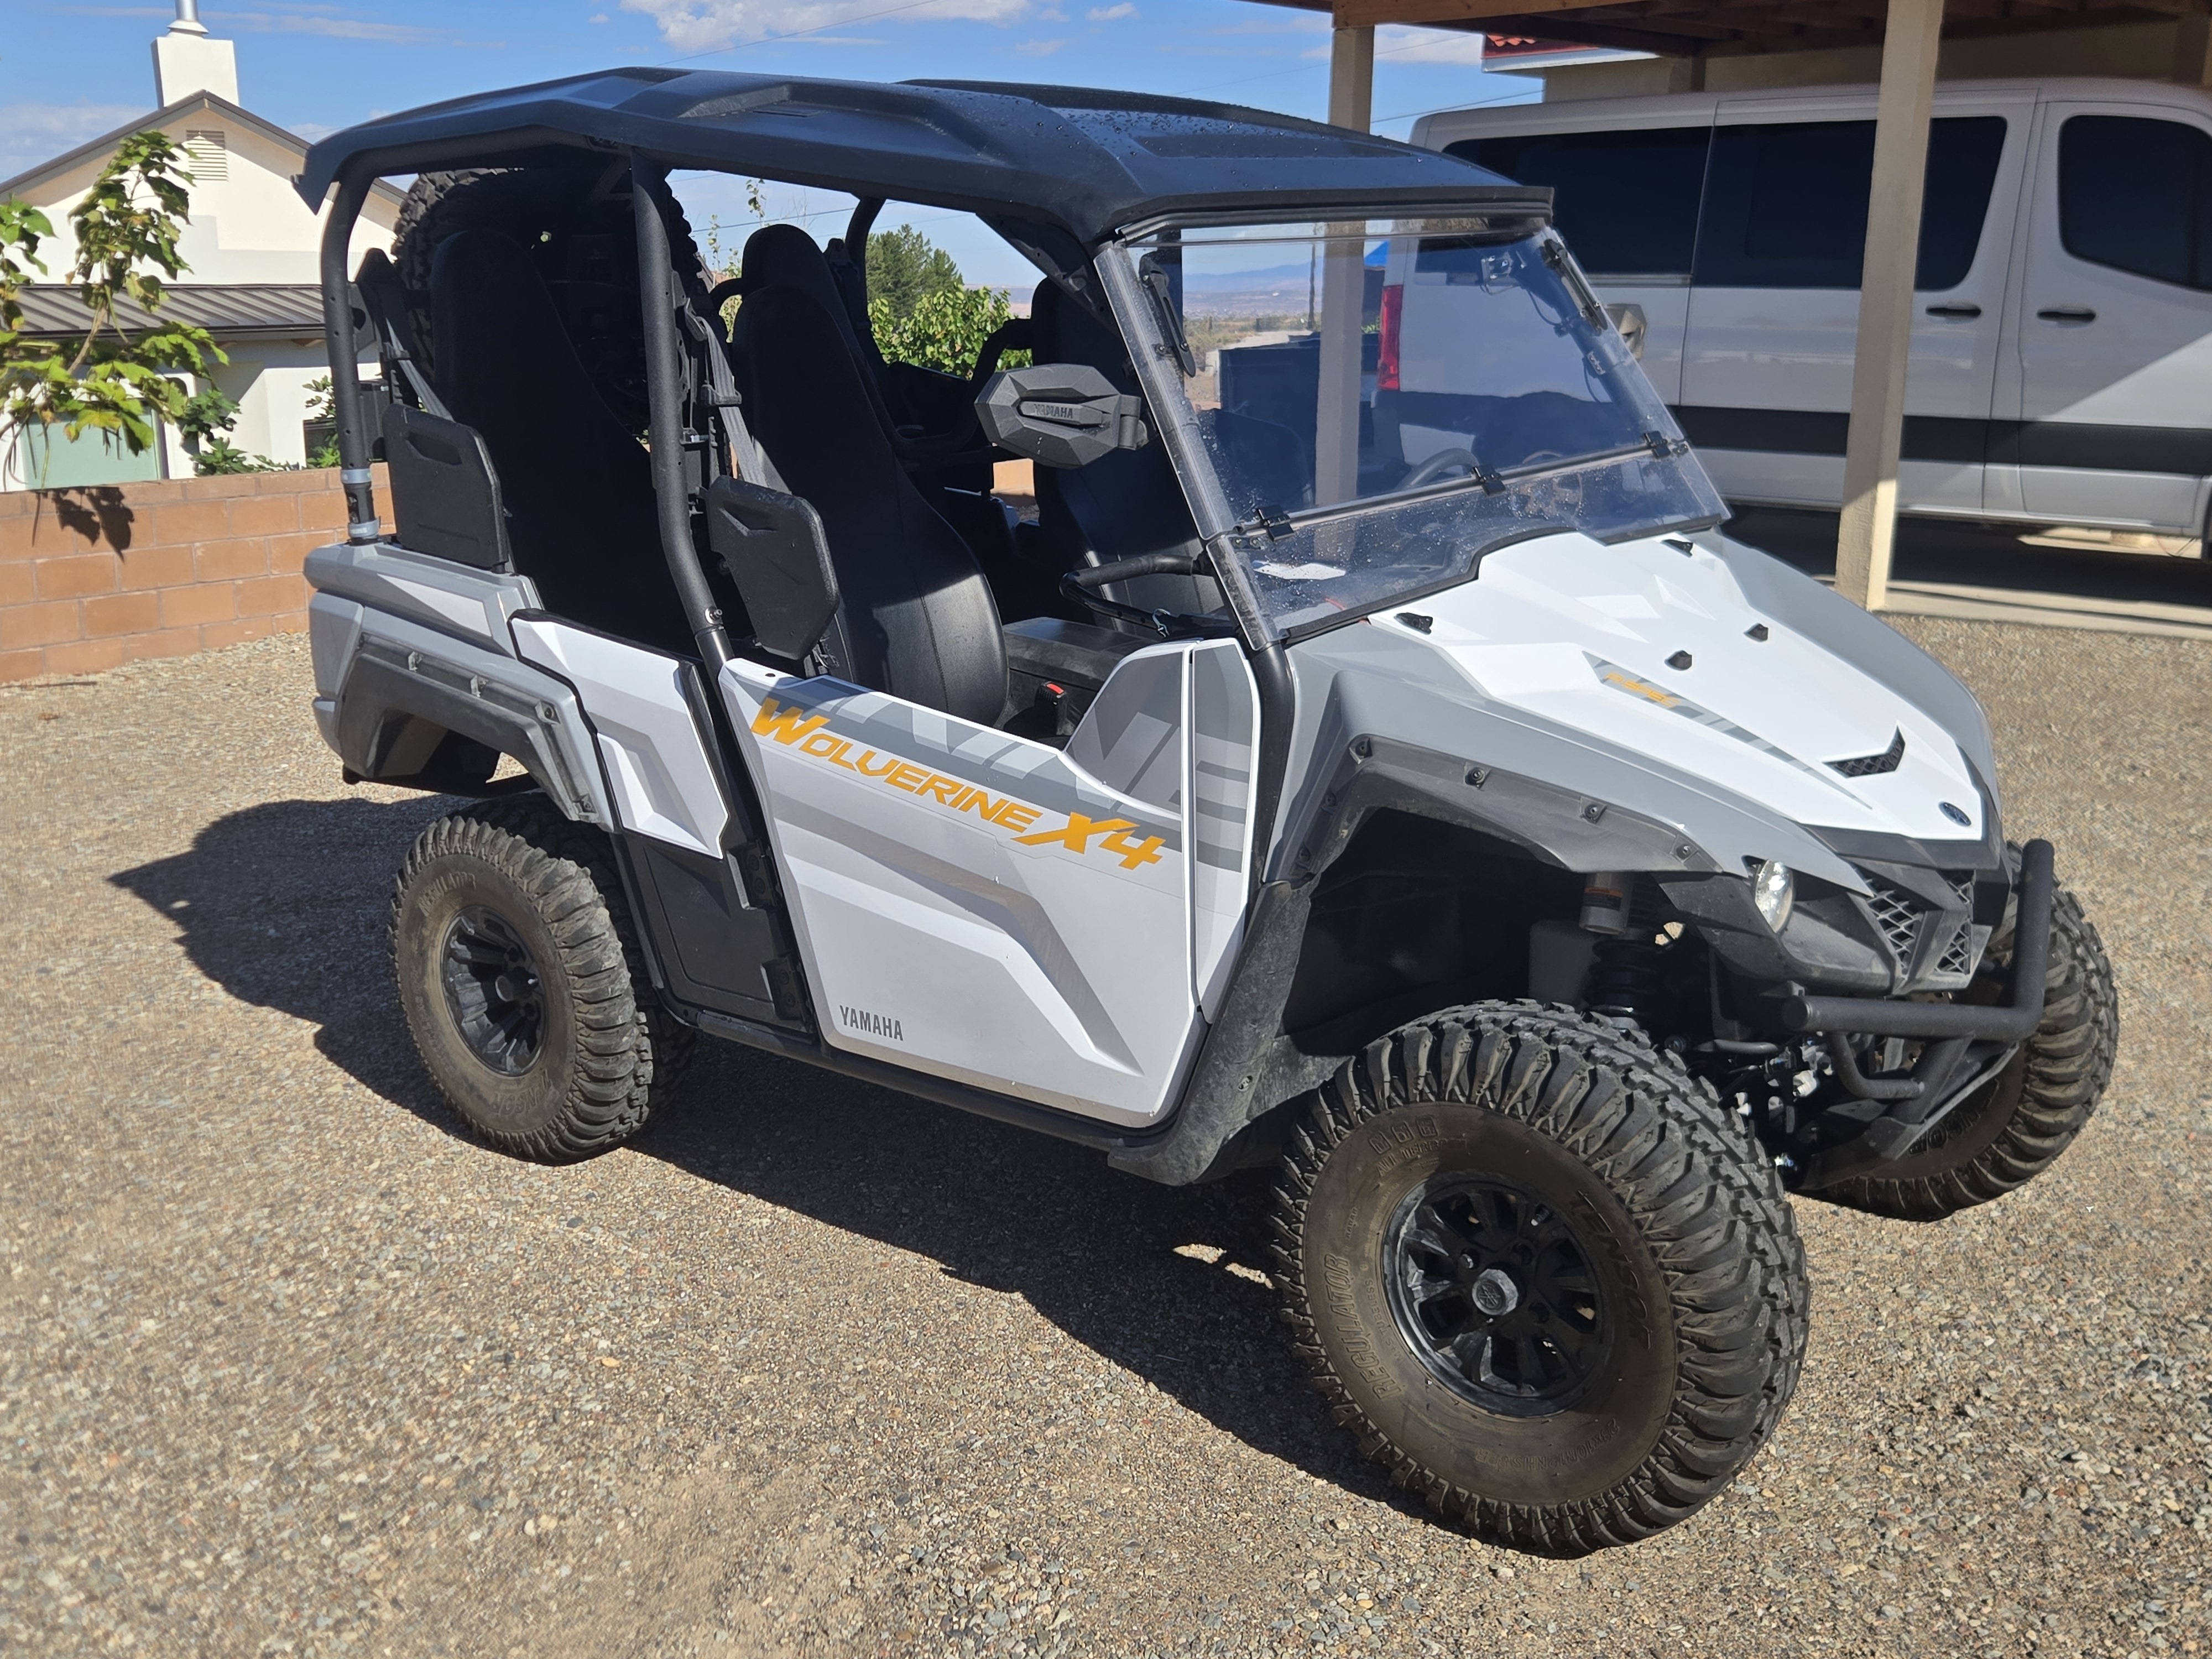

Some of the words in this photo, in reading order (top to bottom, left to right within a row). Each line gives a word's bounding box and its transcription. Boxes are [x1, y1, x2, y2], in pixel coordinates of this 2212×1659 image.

[1033, 403, 1073, 419] YAMAHA
[750, 697, 1043, 832] WOLVERINE
[1011, 812, 1166, 870] X4
[839, 1005, 904, 1041] YAMAHA
[1323, 1254, 1403, 1400] REGULATOR
[1364, 1280, 1390, 1335] TUBELESS
